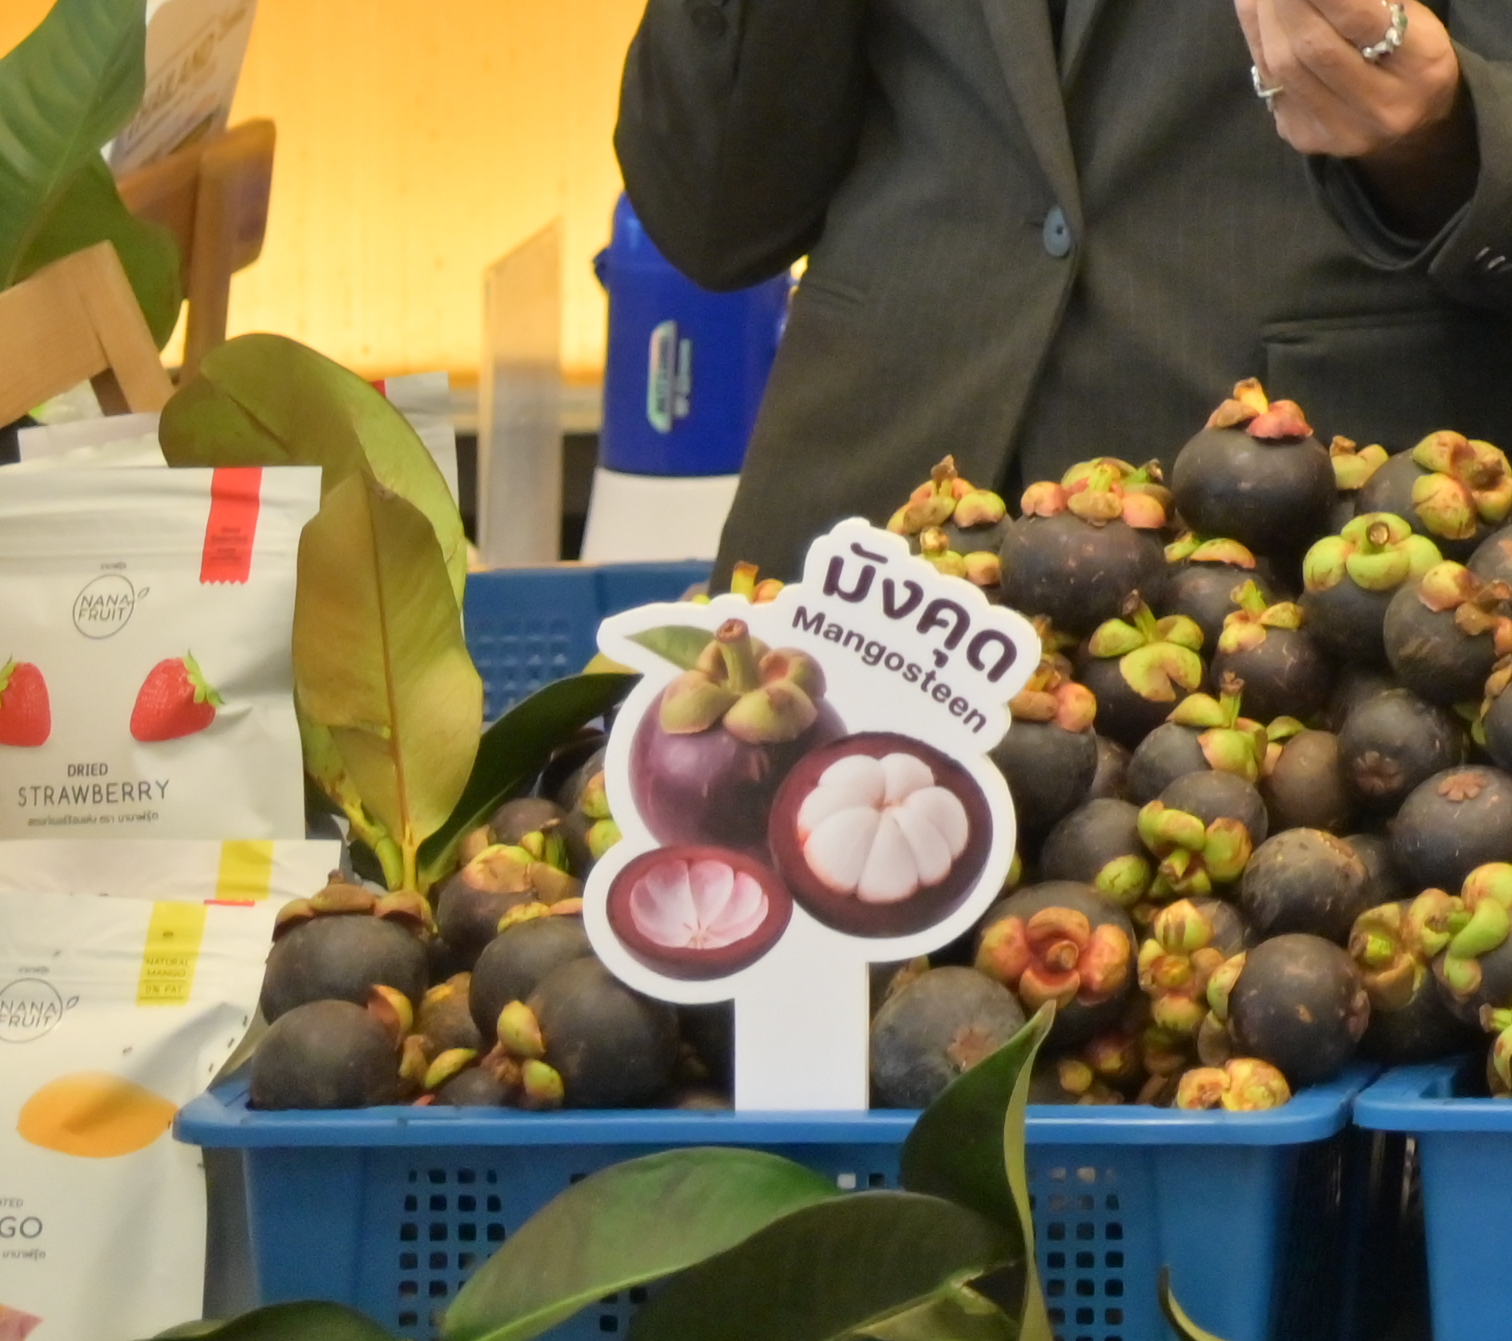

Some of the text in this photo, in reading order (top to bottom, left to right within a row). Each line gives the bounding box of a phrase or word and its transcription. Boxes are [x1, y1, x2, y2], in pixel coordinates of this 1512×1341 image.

[80, 594, 131, 609] NANA
[821, 541, 1018, 684] มังคุด
[78, 607, 127, 622] FRUIT
[791, 605, 987, 734] Mangosteen
[67, 762, 109, 778] DRIED
[17, 778, 170, 808] STRAWBERRY
